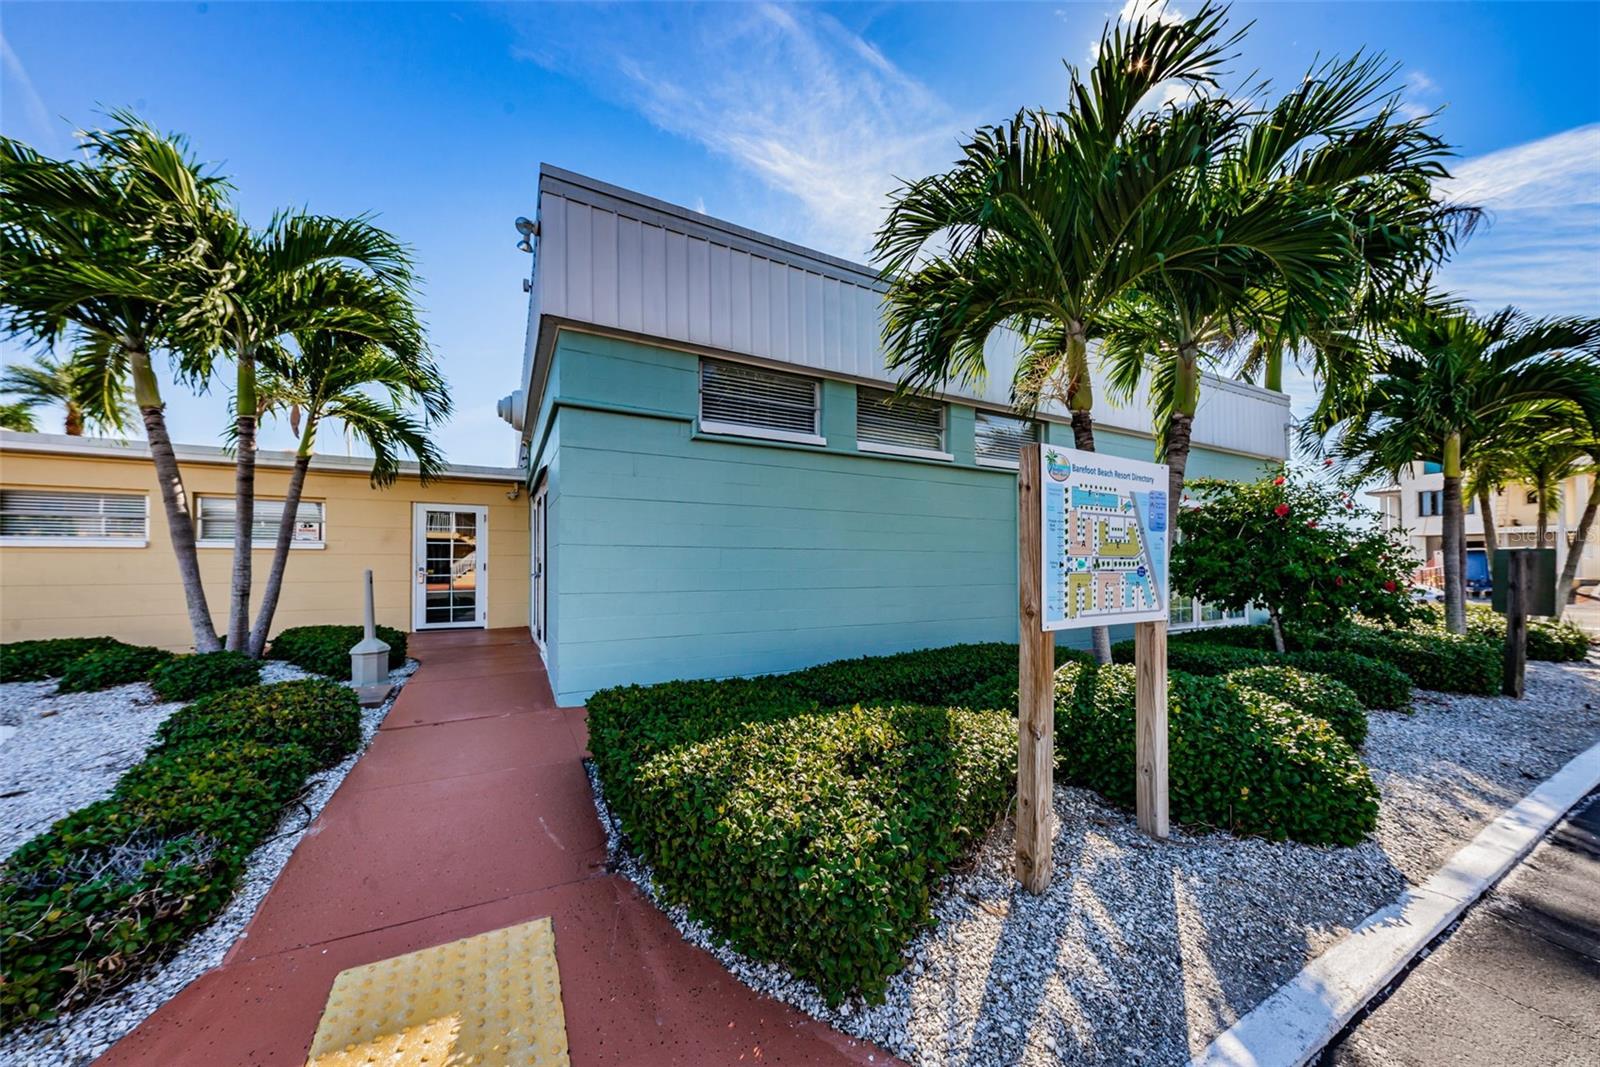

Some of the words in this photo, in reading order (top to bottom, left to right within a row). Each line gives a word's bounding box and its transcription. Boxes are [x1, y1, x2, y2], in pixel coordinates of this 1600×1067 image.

[1072, 464, 1096, 475] Barefoot
[1097, 468, 1113, 478] Beach
[1114, 470, 1131, 480] Resort
[1132, 474, 1154, 484] Directory
